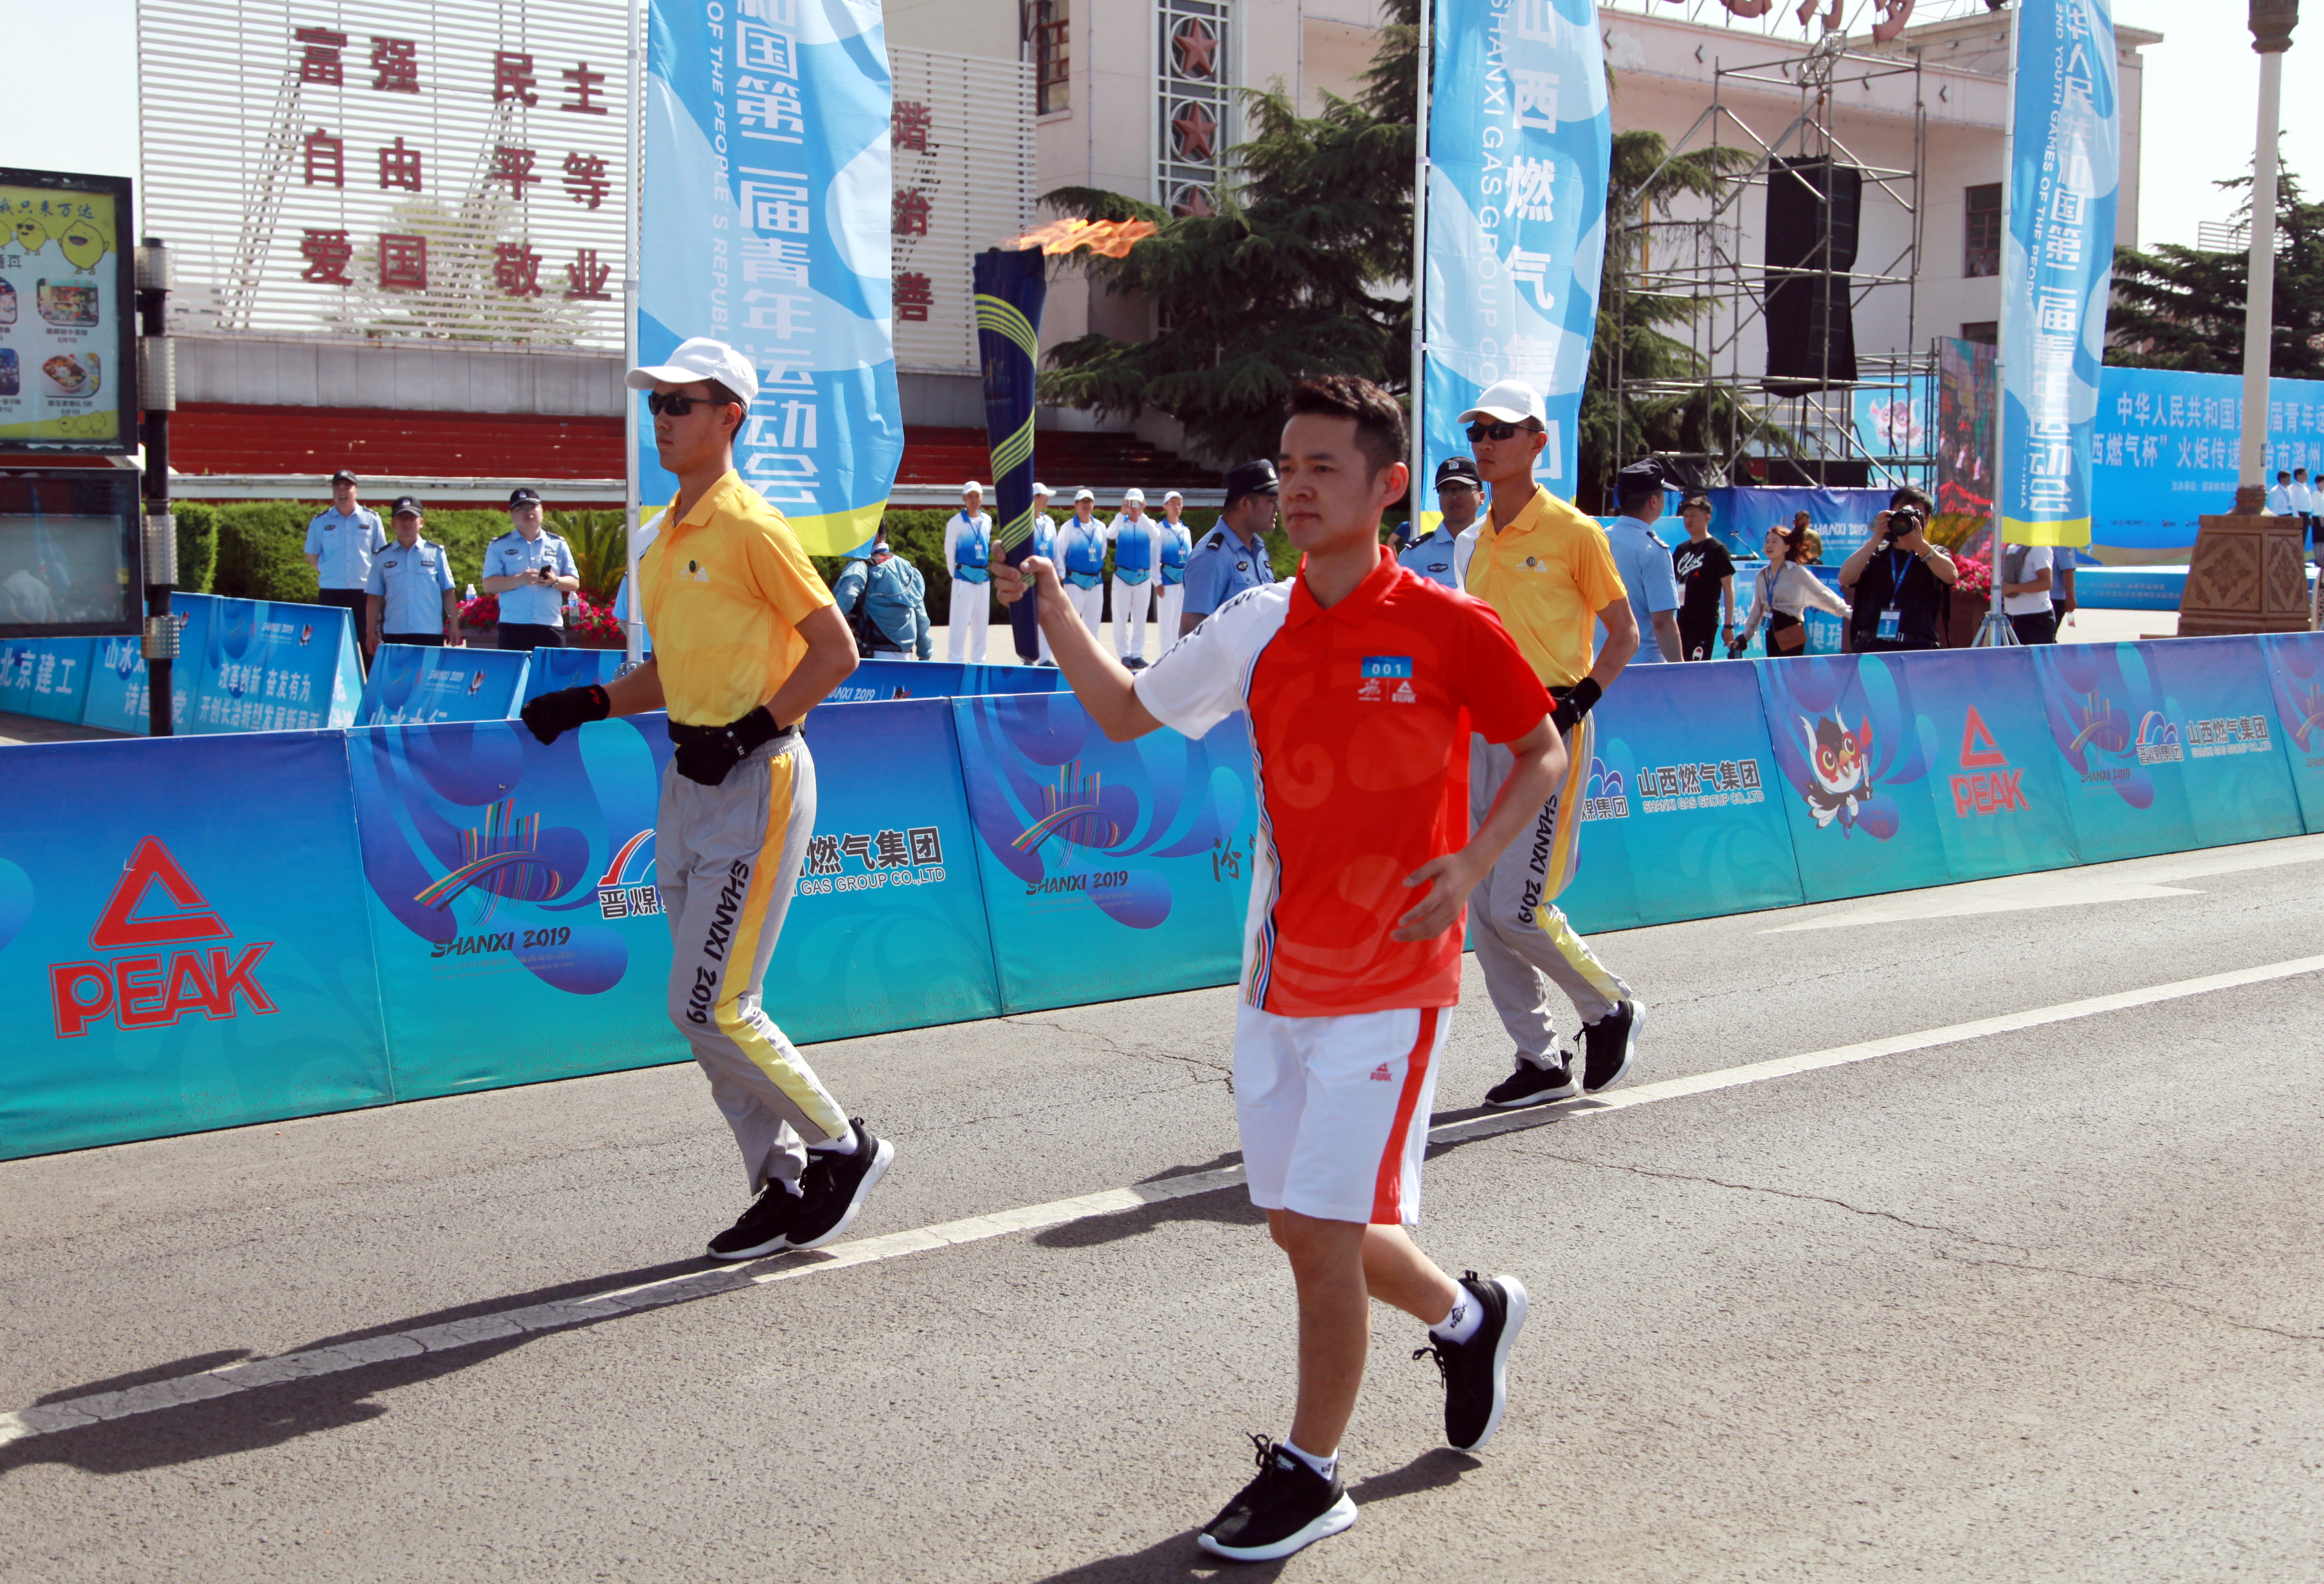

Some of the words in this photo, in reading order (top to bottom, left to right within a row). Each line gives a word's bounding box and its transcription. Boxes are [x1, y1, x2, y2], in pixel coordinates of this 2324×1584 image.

[707, 1, 725, 40] OF
[2055, 2, 2064, 39] 2ND
[295, 27, 420, 95] 富强
[493, 51, 608, 115] 民主
[709, 46, 724, 97] THE
[2053, 45, 2064, 105] YOUTH
[712, 100, 730, 230] PEOPLE'S
[1481, 126, 1504, 195] GAS
[2043, 110, 2062, 172] GAMES
[304, 128, 421, 192] 自由
[494, 146, 611, 210] 平等
[2038, 176, 2051, 202] OF
[2033, 206, 2046, 240] THE
[301, 230, 427, 291] 爱国
[492, 242, 612, 301] 敬业
[1477, 206, 1501, 327] GROUP
[2029, 0, 2093, 513] 华人民共和国第二届青年运动会
[710, 237, 729, 338] REPUBL
[894, 272, 934, 321] 善
[0, 647, 77, 694] 北京建工
[218, 662, 262, 695] 改革创新
[1372, 663, 1402, 675] 001
[854, 688, 876, 700] 2019
[2185, 715, 2270, 746] 山西燃气集团
[1636, 757, 1762, 799] 山西燃气集团
[2080, 769, 2111, 783] SHANXI
[2113, 767, 2131, 780] 2019
[2306, 757, 2324, 768] SHAN
[1643, 799, 1677, 814] SHANXI
[1677, 797, 1697, 811] GAS
[1697, 793, 1731, 809] GROUP
[1947, 767, 2032, 819] PEAK
[1528, 795, 1558, 875] SHANXI
[600, 888, 666, 920] 晋煤
[799, 826, 944, 879] 燃气集团
[800, 879, 833, 896] GAS
[835, 873, 887, 894] GROUP
[1026, 873, 1087, 895] SHANXI
[1092, 870, 1129, 889] 2019
[703, 859, 749, 962] SHANXI
[1517, 879, 1543, 924] 2019
[431, 932, 514, 958] SHANXI
[522, 926, 571, 949] 2019
[48, 940, 281, 1040] PEAK
[685, 966, 717, 1024] 2019
